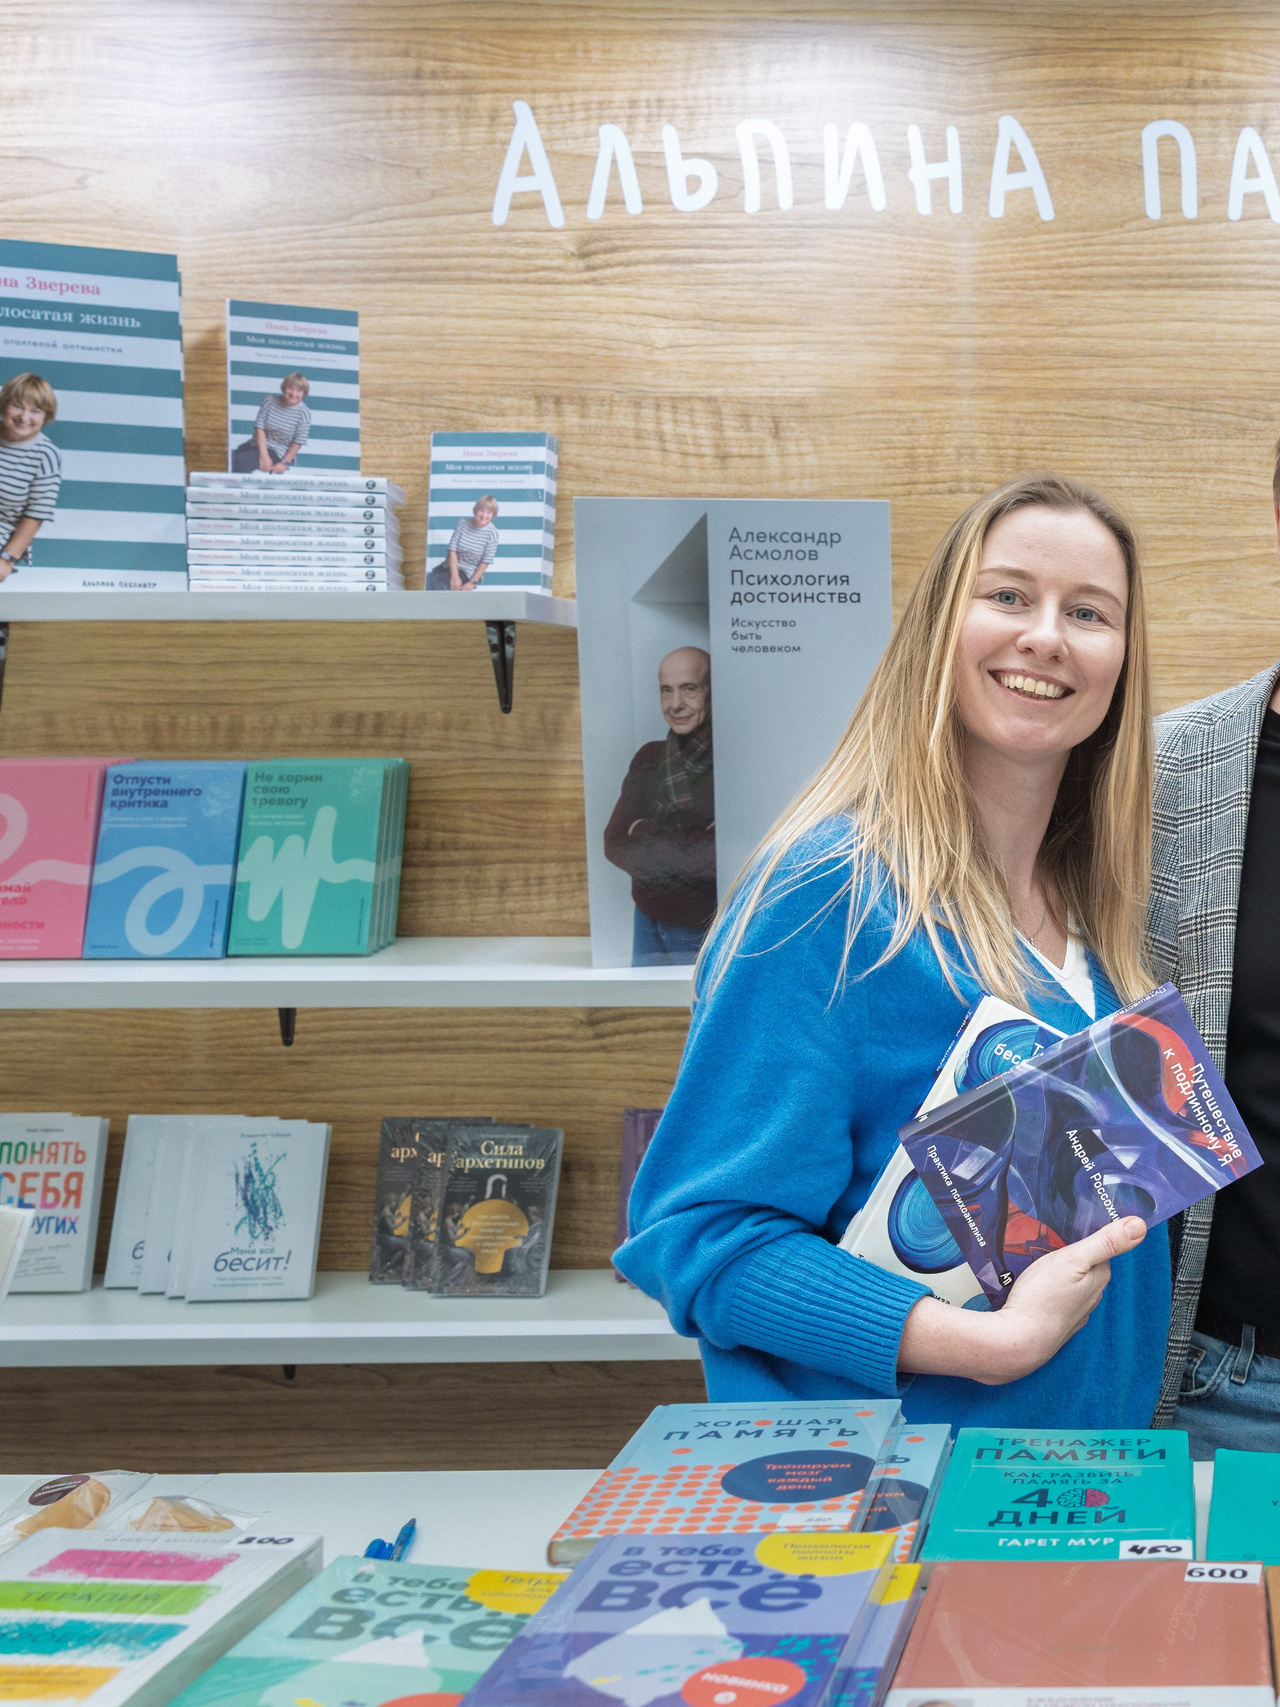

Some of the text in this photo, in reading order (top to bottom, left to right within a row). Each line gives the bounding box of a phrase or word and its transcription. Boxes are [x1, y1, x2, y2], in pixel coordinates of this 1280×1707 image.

[26, 276, 100, 295] Зверева
[80, 313, 141, 328] жизнь
[63, 343, 123, 353] оптимистки
[729, 527, 842, 548] Александр
[729, 545, 819, 561] Асмолов
[731, 570, 850, 586] Психология
[731, 591, 861, 606] достоинства
[731, 617, 797, 630] Искусство
[731, 630, 762, 640] быть
[731, 645, 801, 653] человеком
[113, 775, 171, 788] Отпусти
[278, 773, 323, 786] корми
[112, 787, 202, 798] внутреннего
[110, 800, 168, 811] критика
[1171, 1062, 1223, 1151] подлинному
[1218, 1152, 1234, 1167] Я
[1189, 1063, 1243, 1160] Путешествие
[0, 1141, 86, 1164] ПОНЯТЬ
[481, 1140, 523, 1156] Сила
[456, 1157, 546, 1174] архетипов
[1066, 1129, 1121, 1223] Андрей Россохи
[927, 1144, 987, 1248] Практика психоанализа
[213, 1250, 292, 1272] бесит!
[663, 1428, 859, 1441] ПАМЯТЬ
[995, 1437, 1152, 1447] ТРЕНАЖЕР
[975, 1447, 1167, 1461] ПАМЯТИ
[765, 1463, 852, 1471] Тренируем
[767, 1476, 833, 1484] каждый
[988, 1506, 1126, 1528] ДНЕЙ
[998, 1537, 1115, 1547] ГАРЕТ МУР
[1128, 1544, 1183, 1555] 450
[660, 1543, 745, 1557] тебе
[607, 1560, 765, 1577] есть
[1187, 1567, 1249, 1579] 600
[388, 1575, 470, 1591] тебе
[22, 1591, 163, 1603] ТЕРАПИЯ
[331, 1587, 484, 1612] есть
[701, 1672, 789, 1695] новинка
